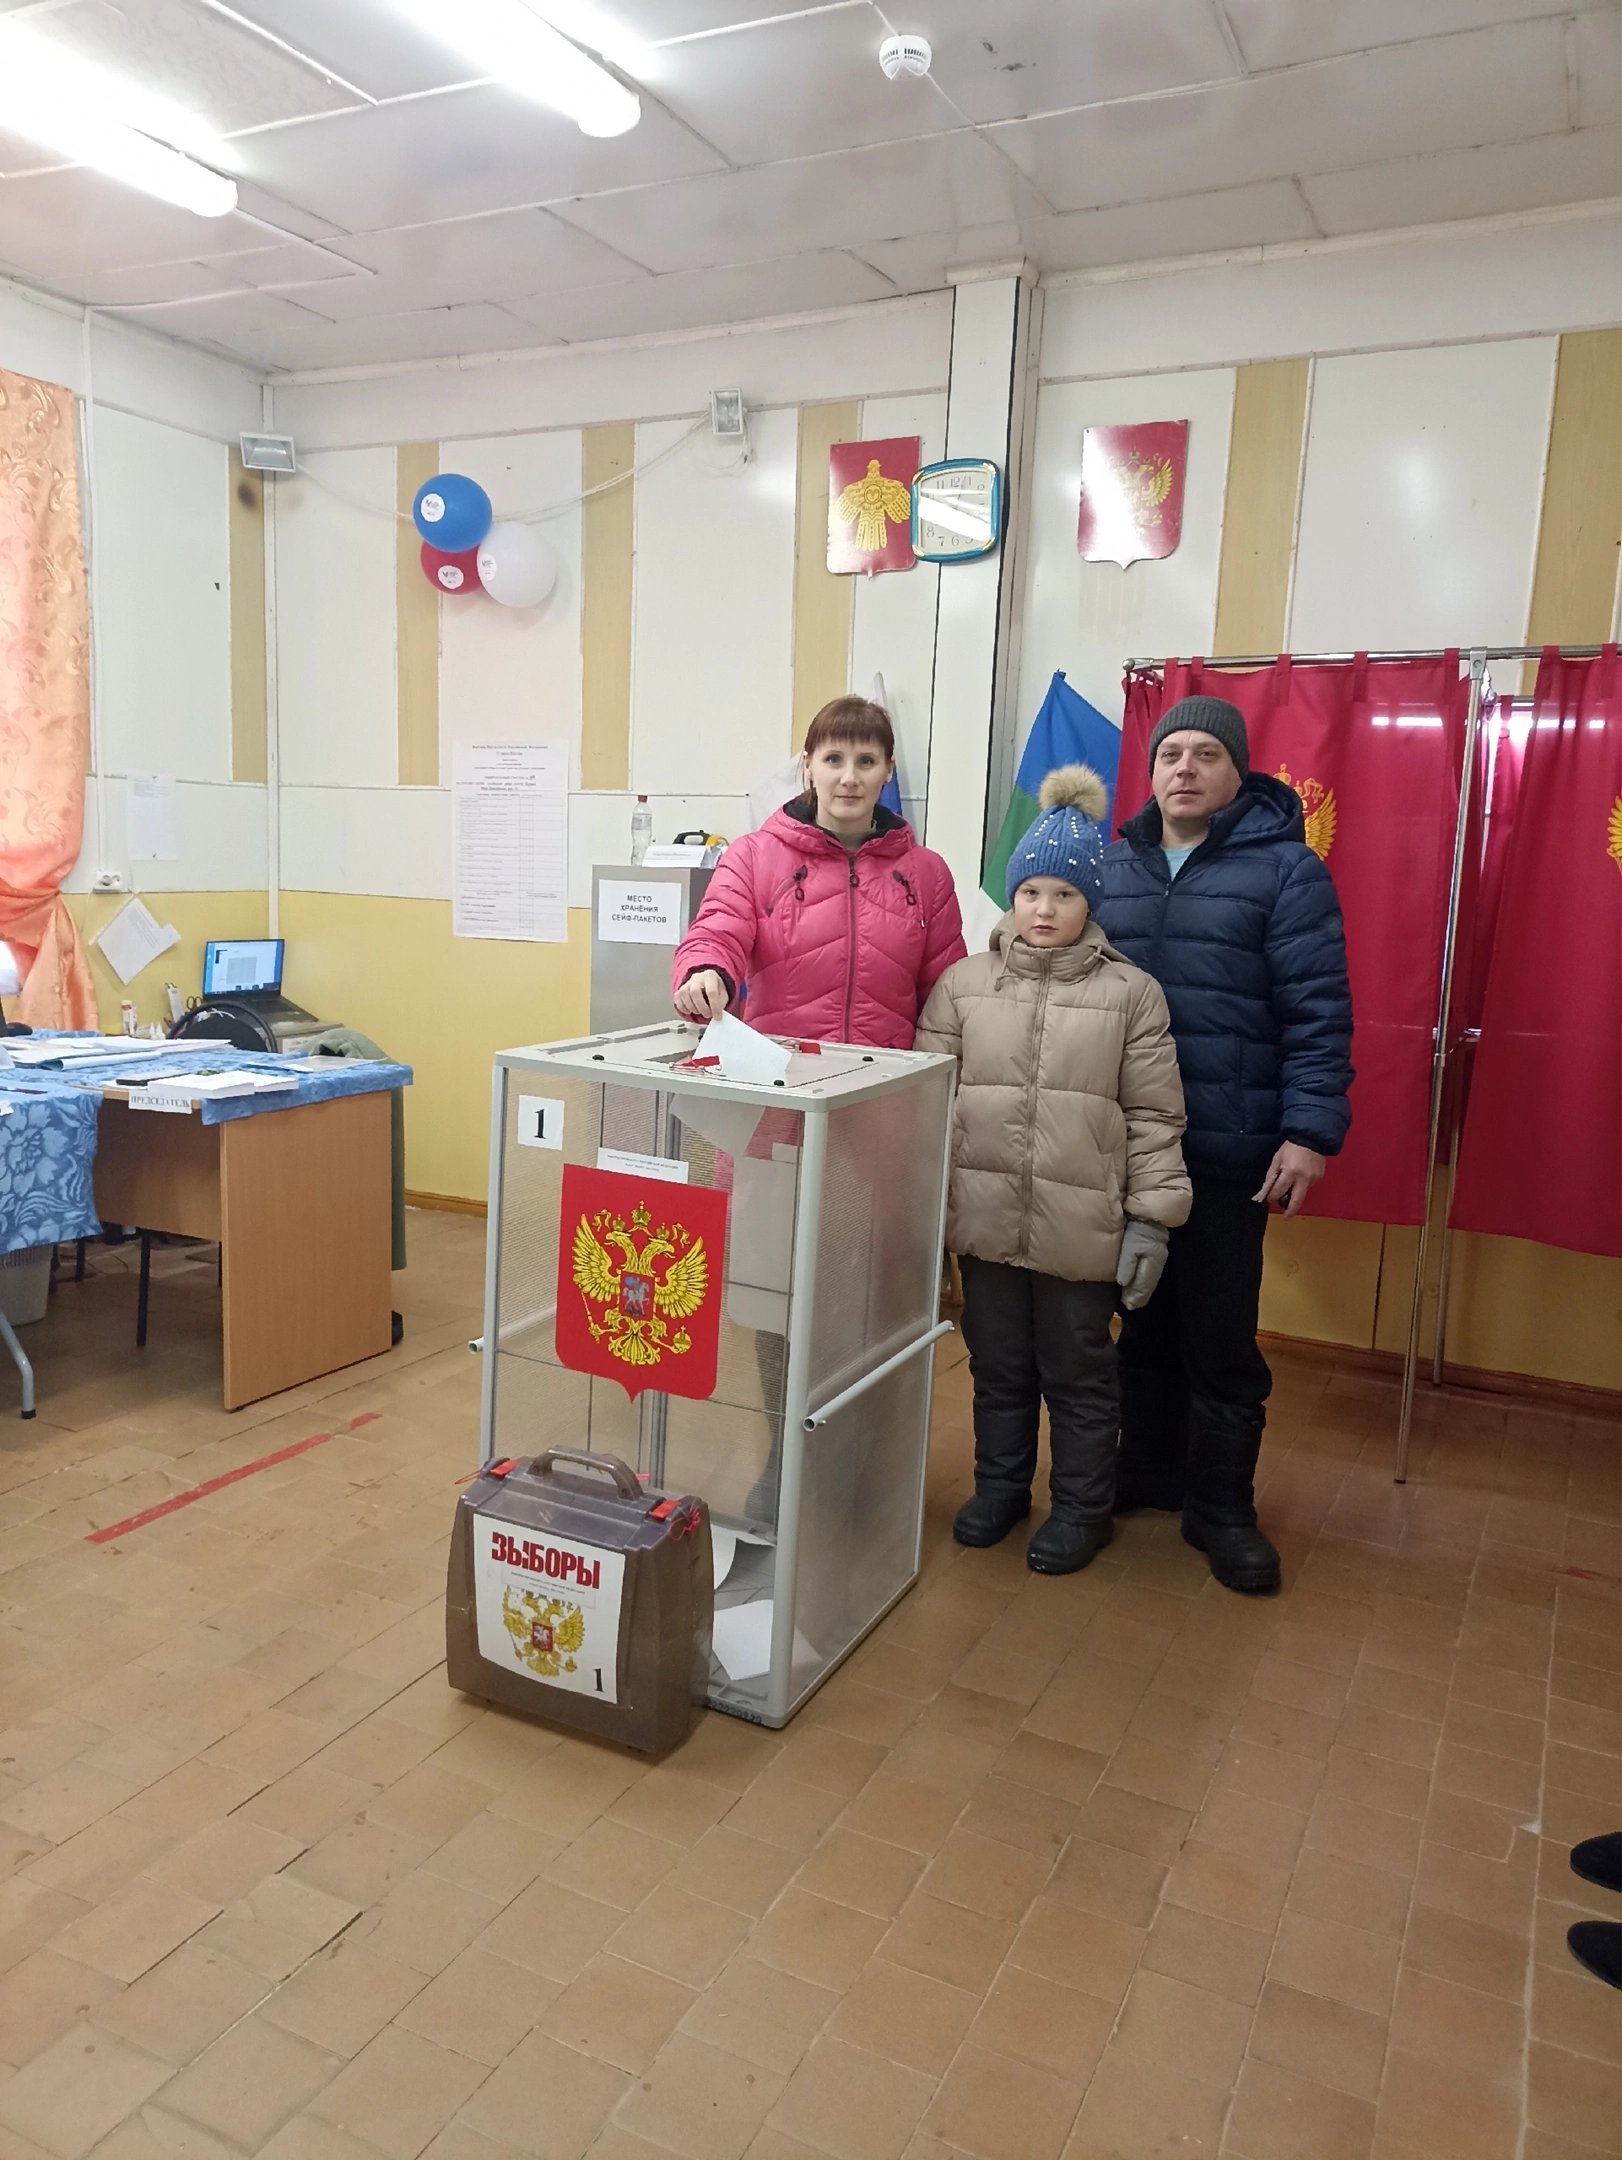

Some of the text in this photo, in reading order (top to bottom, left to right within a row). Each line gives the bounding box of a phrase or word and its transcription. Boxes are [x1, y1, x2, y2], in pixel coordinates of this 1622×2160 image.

[620, 904, 659, 912] ХРАНЕНИЯ
[611, 913, 667, 923] СЕЙФ-ПАКЕТОВ
[533, 1108, 547, 1140] 1
[593, 1667, 605, 1694] 1
